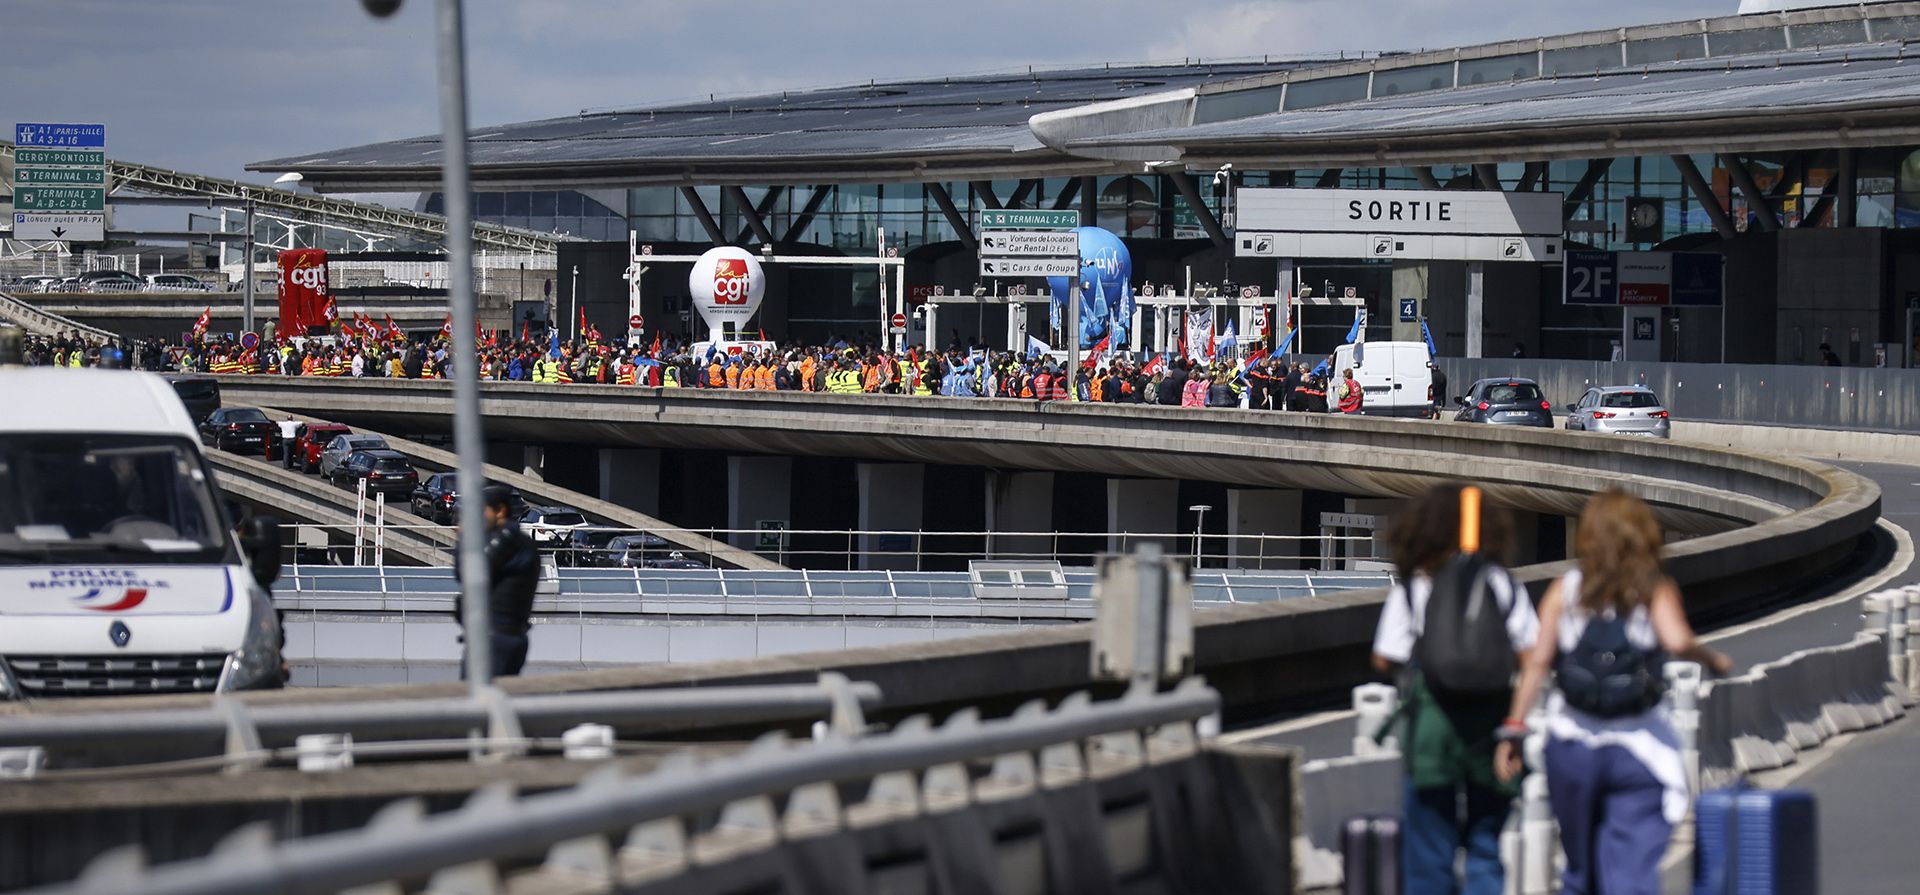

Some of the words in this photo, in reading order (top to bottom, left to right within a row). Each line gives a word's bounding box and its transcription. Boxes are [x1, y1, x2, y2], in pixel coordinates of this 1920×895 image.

[18, 153, 101, 162] CERGY-PONTOISE
[33, 171, 81, 181] TERMINAL
[86, 172, 101, 181] 1-3
[38, 189, 85, 198] TERMINAL
[90, 190, 97, 198] 2
[36, 200, 88, 208] A-B-C-D-E
[1348, 200, 1451, 221] SORTIE
[1009, 216, 1051, 224] TERMINAL
[1053, 216, 1059, 224] 2
[1061, 216, 1076, 224] F-G
[1010, 234, 1038, 242] Voitures
[1046, 235, 1075, 243] Location
[1008, 244, 1022, 252] Car
[1023, 244, 1048, 252] Rental
[1012, 264, 1030, 272] Cars
[1033, 264, 1043, 272] de
[1046, 264, 1075, 273] Groupe
[291, 263, 326, 289] cgt
[1571, 266, 1612, 298] 2F
[316, 284, 327, 296] 93
[713, 273, 750, 302] cgt
[1404, 304, 1412, 316] 4
[49, 569, 137, 578] POLICE
[28, 579, 170, 589] NATIONALE
